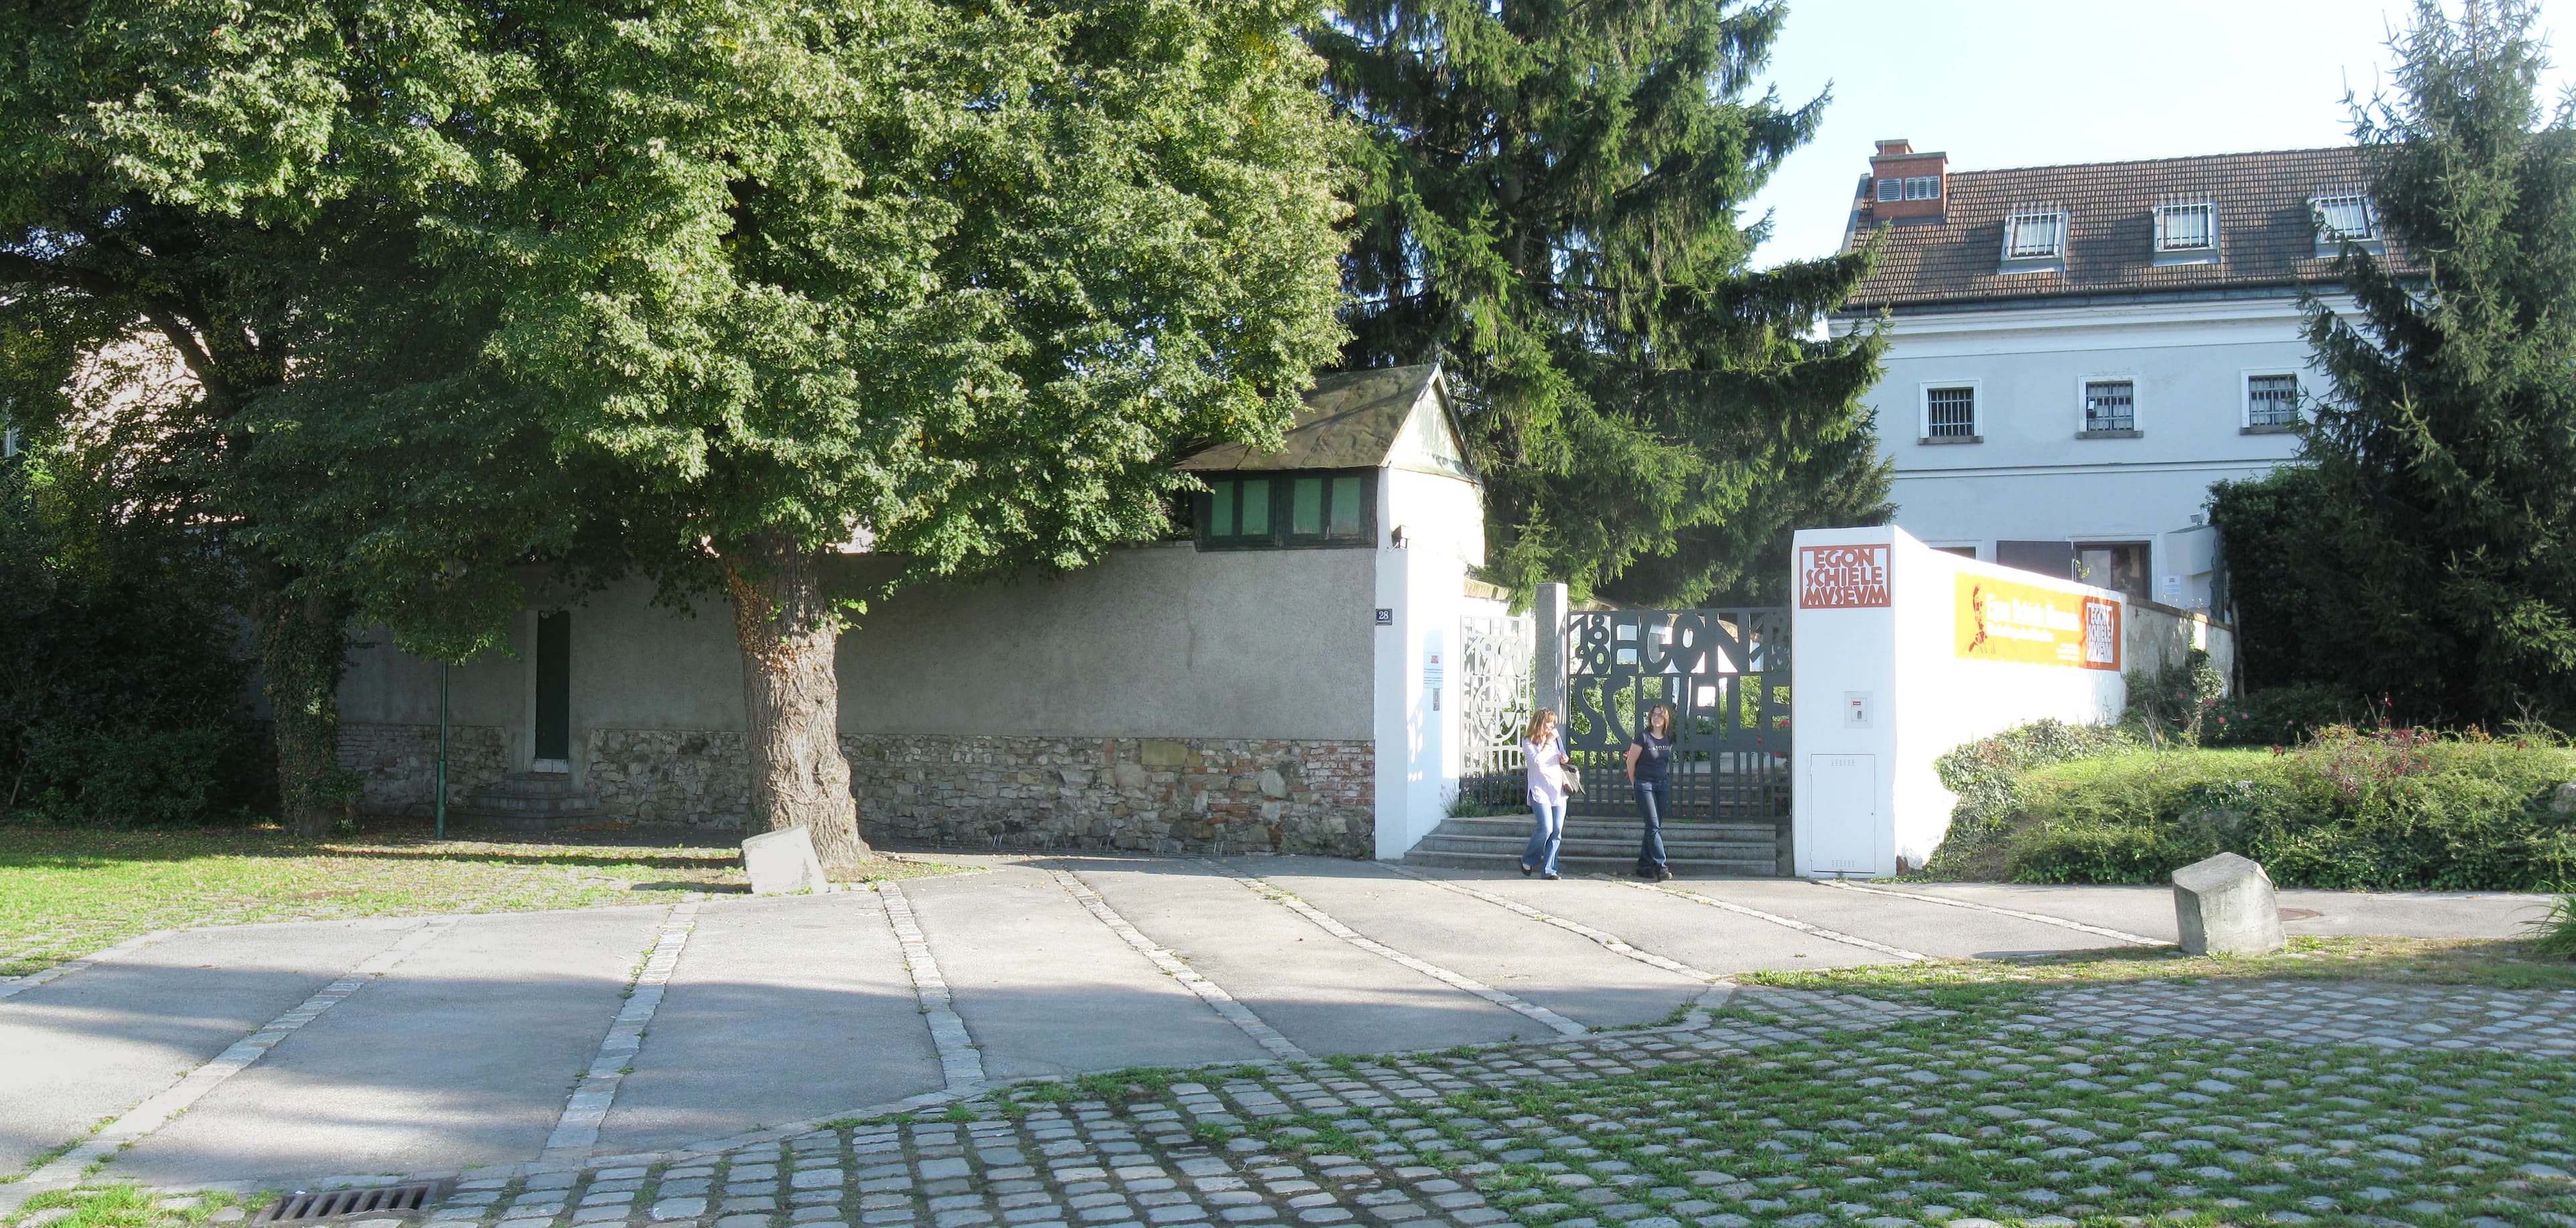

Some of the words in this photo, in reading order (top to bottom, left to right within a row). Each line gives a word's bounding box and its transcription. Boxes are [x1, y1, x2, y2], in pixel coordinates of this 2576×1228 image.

[1813, 549, 1875, 569] EGON
[1805, 566, 1884, 588] SCHIELE
[1379, 610, 1389, 620] 28
[1610, 613, 1748, 673] EGON
